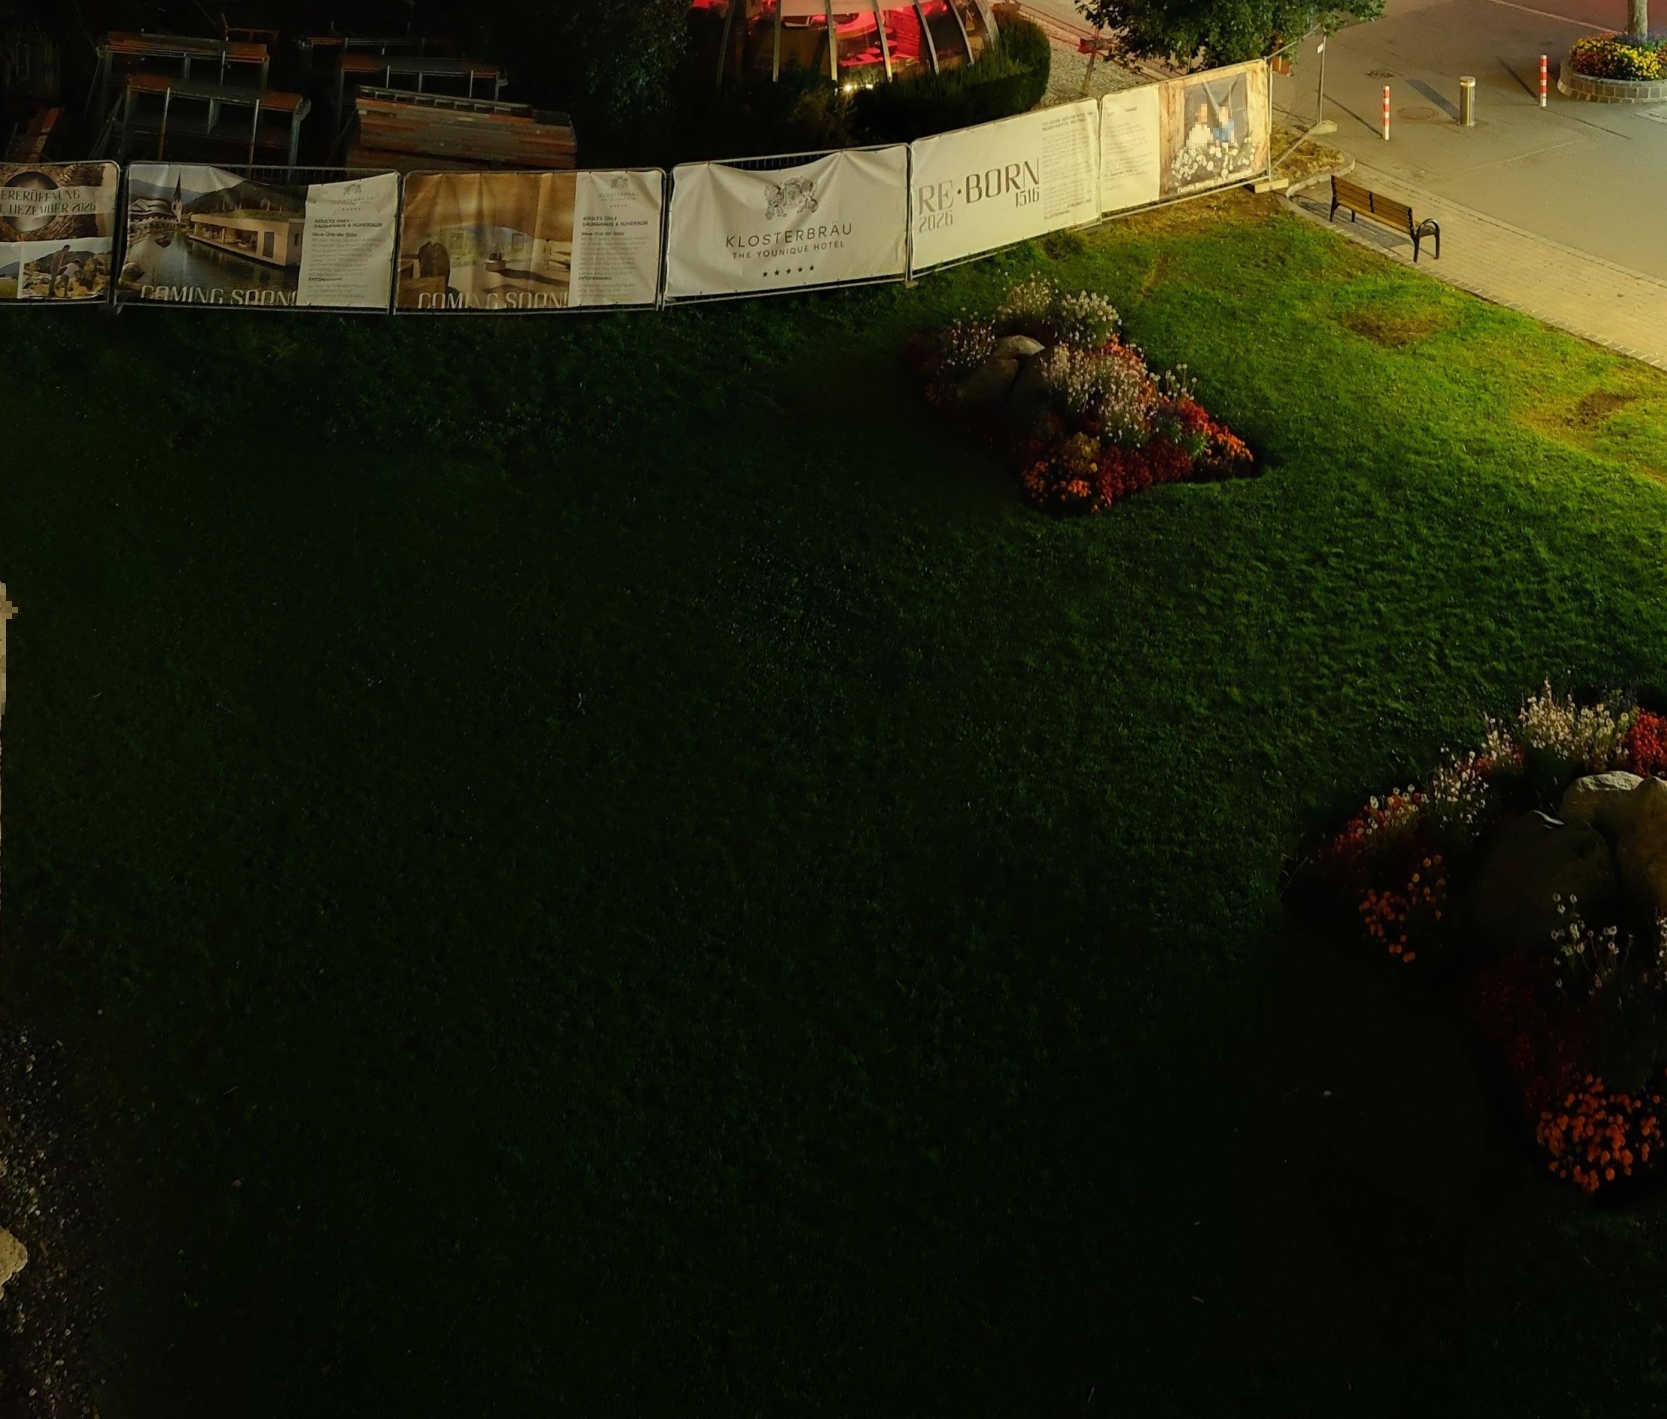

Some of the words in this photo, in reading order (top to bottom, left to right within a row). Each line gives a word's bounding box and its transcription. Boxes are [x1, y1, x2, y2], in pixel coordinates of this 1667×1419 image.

[1015, 187, 1040, 208] 1516
[726, 222, 852, 248] KLOSTERBRÄU
[732, 251, 751, 260] THE
[757, 245, 809, 259] YOUNIQUE
[813, 240, 845, 252] HOTEL
